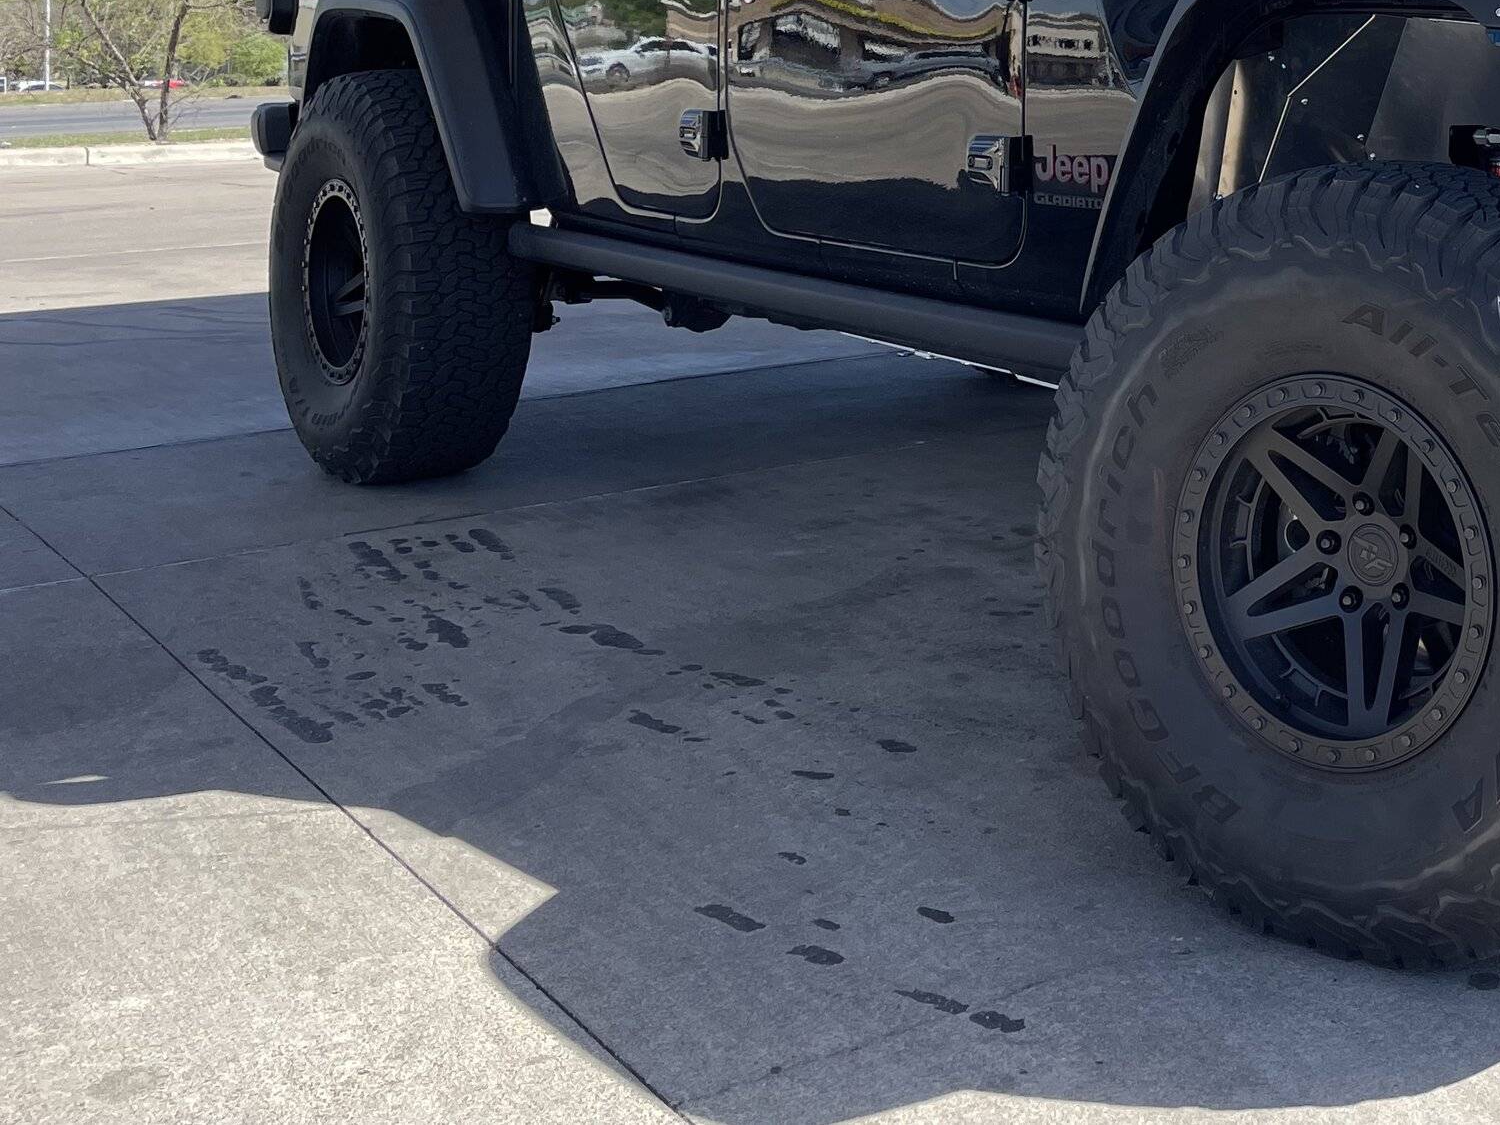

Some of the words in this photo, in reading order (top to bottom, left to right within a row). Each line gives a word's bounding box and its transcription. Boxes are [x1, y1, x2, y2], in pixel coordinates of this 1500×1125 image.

[1035, 145, 1109, 193] Jeep
[1034, 192, 1104, 210] GLADIATO
[1092, 381, 1240, 824] BFGoodrich
